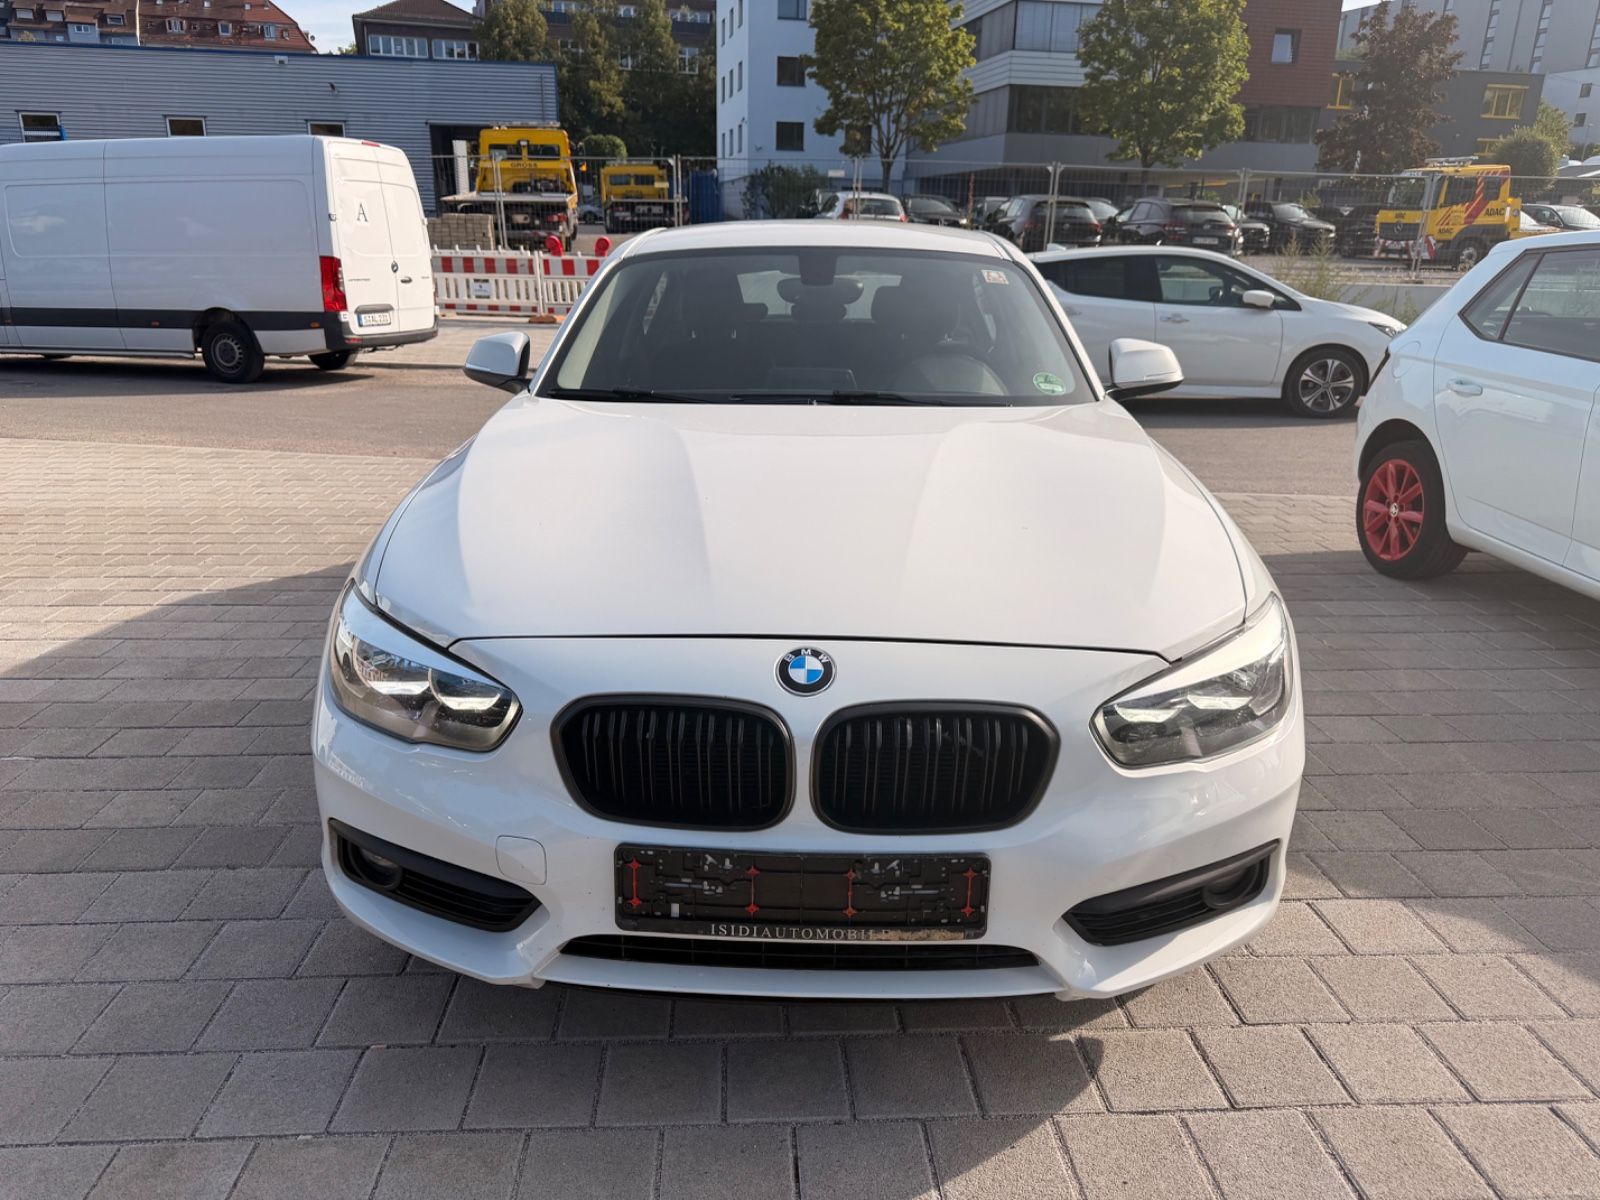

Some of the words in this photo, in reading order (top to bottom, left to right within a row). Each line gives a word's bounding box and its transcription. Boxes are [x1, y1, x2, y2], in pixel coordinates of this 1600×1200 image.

[357, 203, 368, 222] A
[1485, 208, 1505, 217] ADAC
[783, 648, 831, 663] BMW
